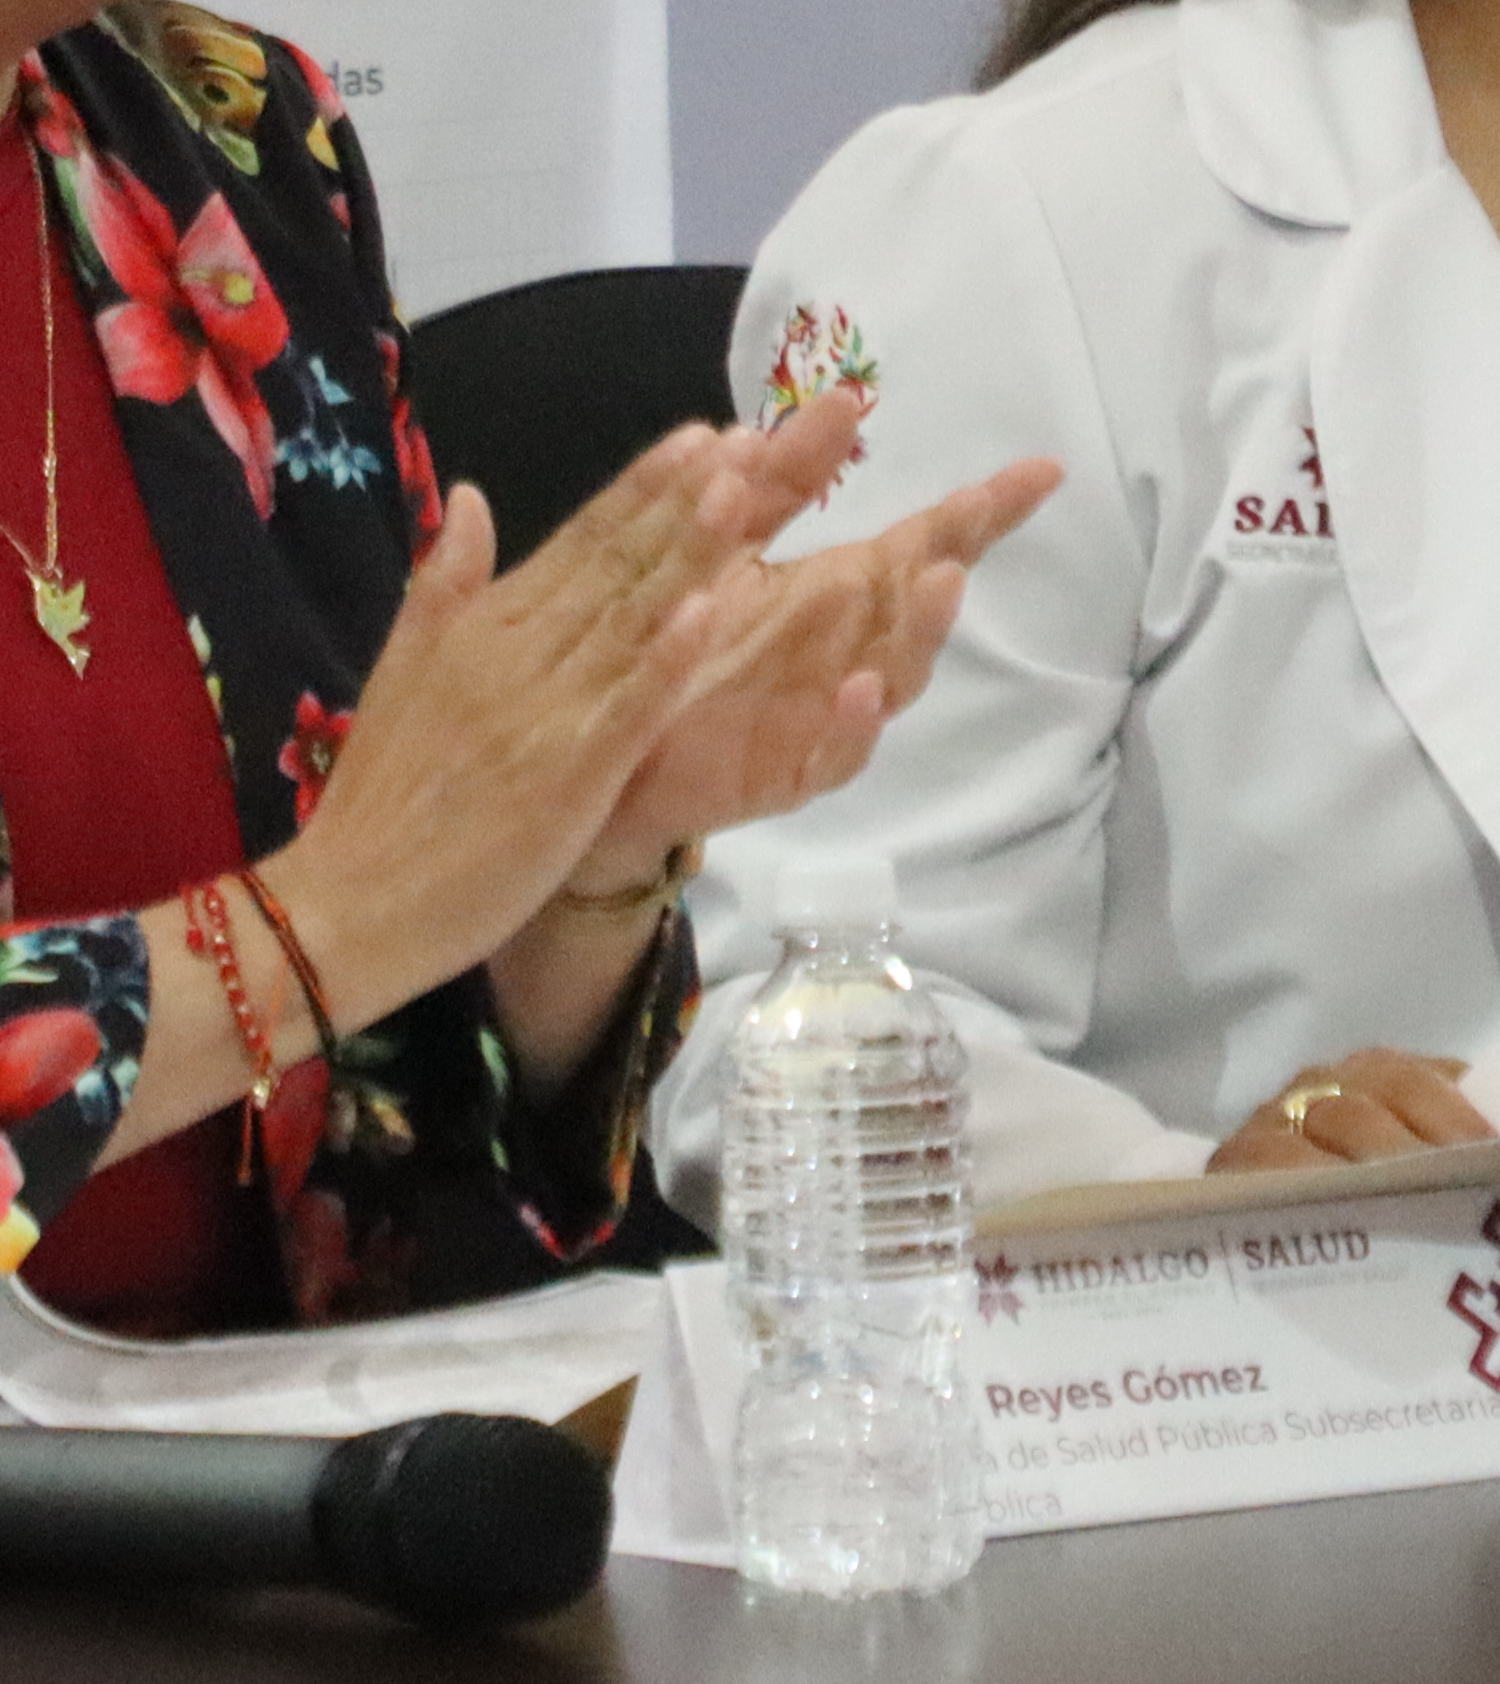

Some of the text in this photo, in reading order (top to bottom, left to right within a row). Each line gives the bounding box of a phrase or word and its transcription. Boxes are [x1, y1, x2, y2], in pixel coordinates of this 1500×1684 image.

[1032, 1249, 1210, 1294] HIDALGO
[1242, 1230, 1371, 1270] SALUD
[986, 1362, 1269, 1422] Reyes Gómez
[1057, 1431, 1151, 1466] Salud
[1158, 1418, 1278, 1456] Pública
